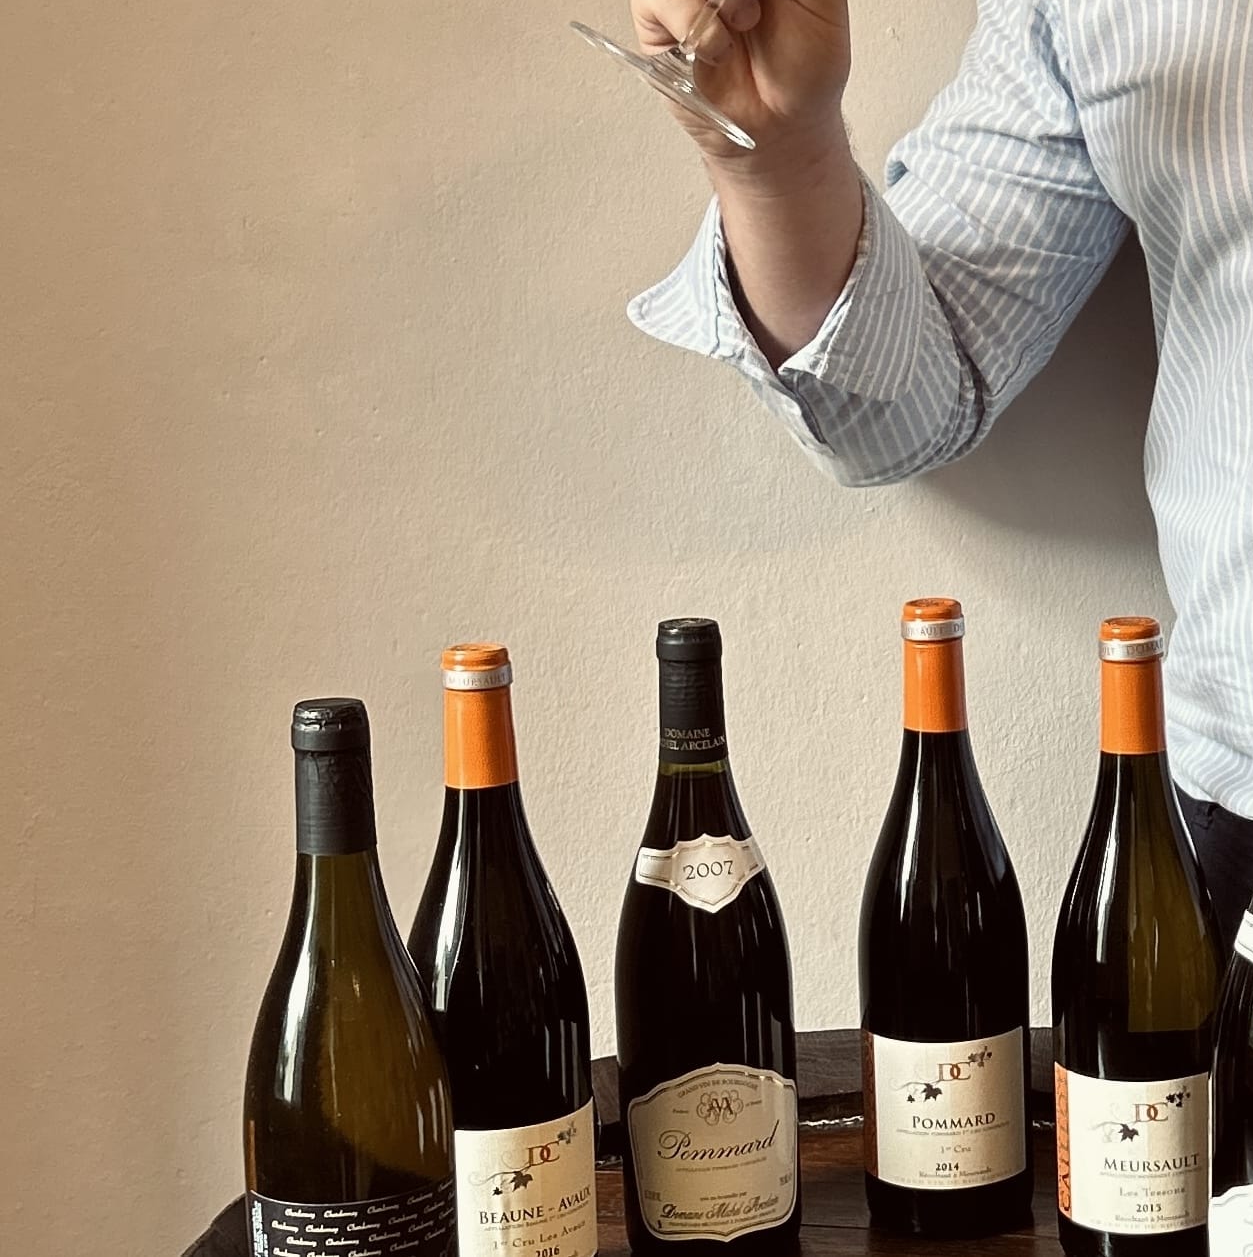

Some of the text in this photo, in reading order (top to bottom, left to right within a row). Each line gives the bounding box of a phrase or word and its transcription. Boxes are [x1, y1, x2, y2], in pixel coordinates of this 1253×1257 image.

[664, 727, 710, 739] DOMAINE
[683, 860, 733, 880] 2007
[912, 1112, 995, 1129] POMMARD
[657, 1119, 780, 1161] Pommard
[935, 1162, 959, 1172] 2014
[1104, 1154, 1199, 1173] MEURSAULT
[479, 1206, 544, 1225] BEAUNE
[1136, 1203, 1162, 1213] 2015
[512, 1237, 535, 1248] Cru
